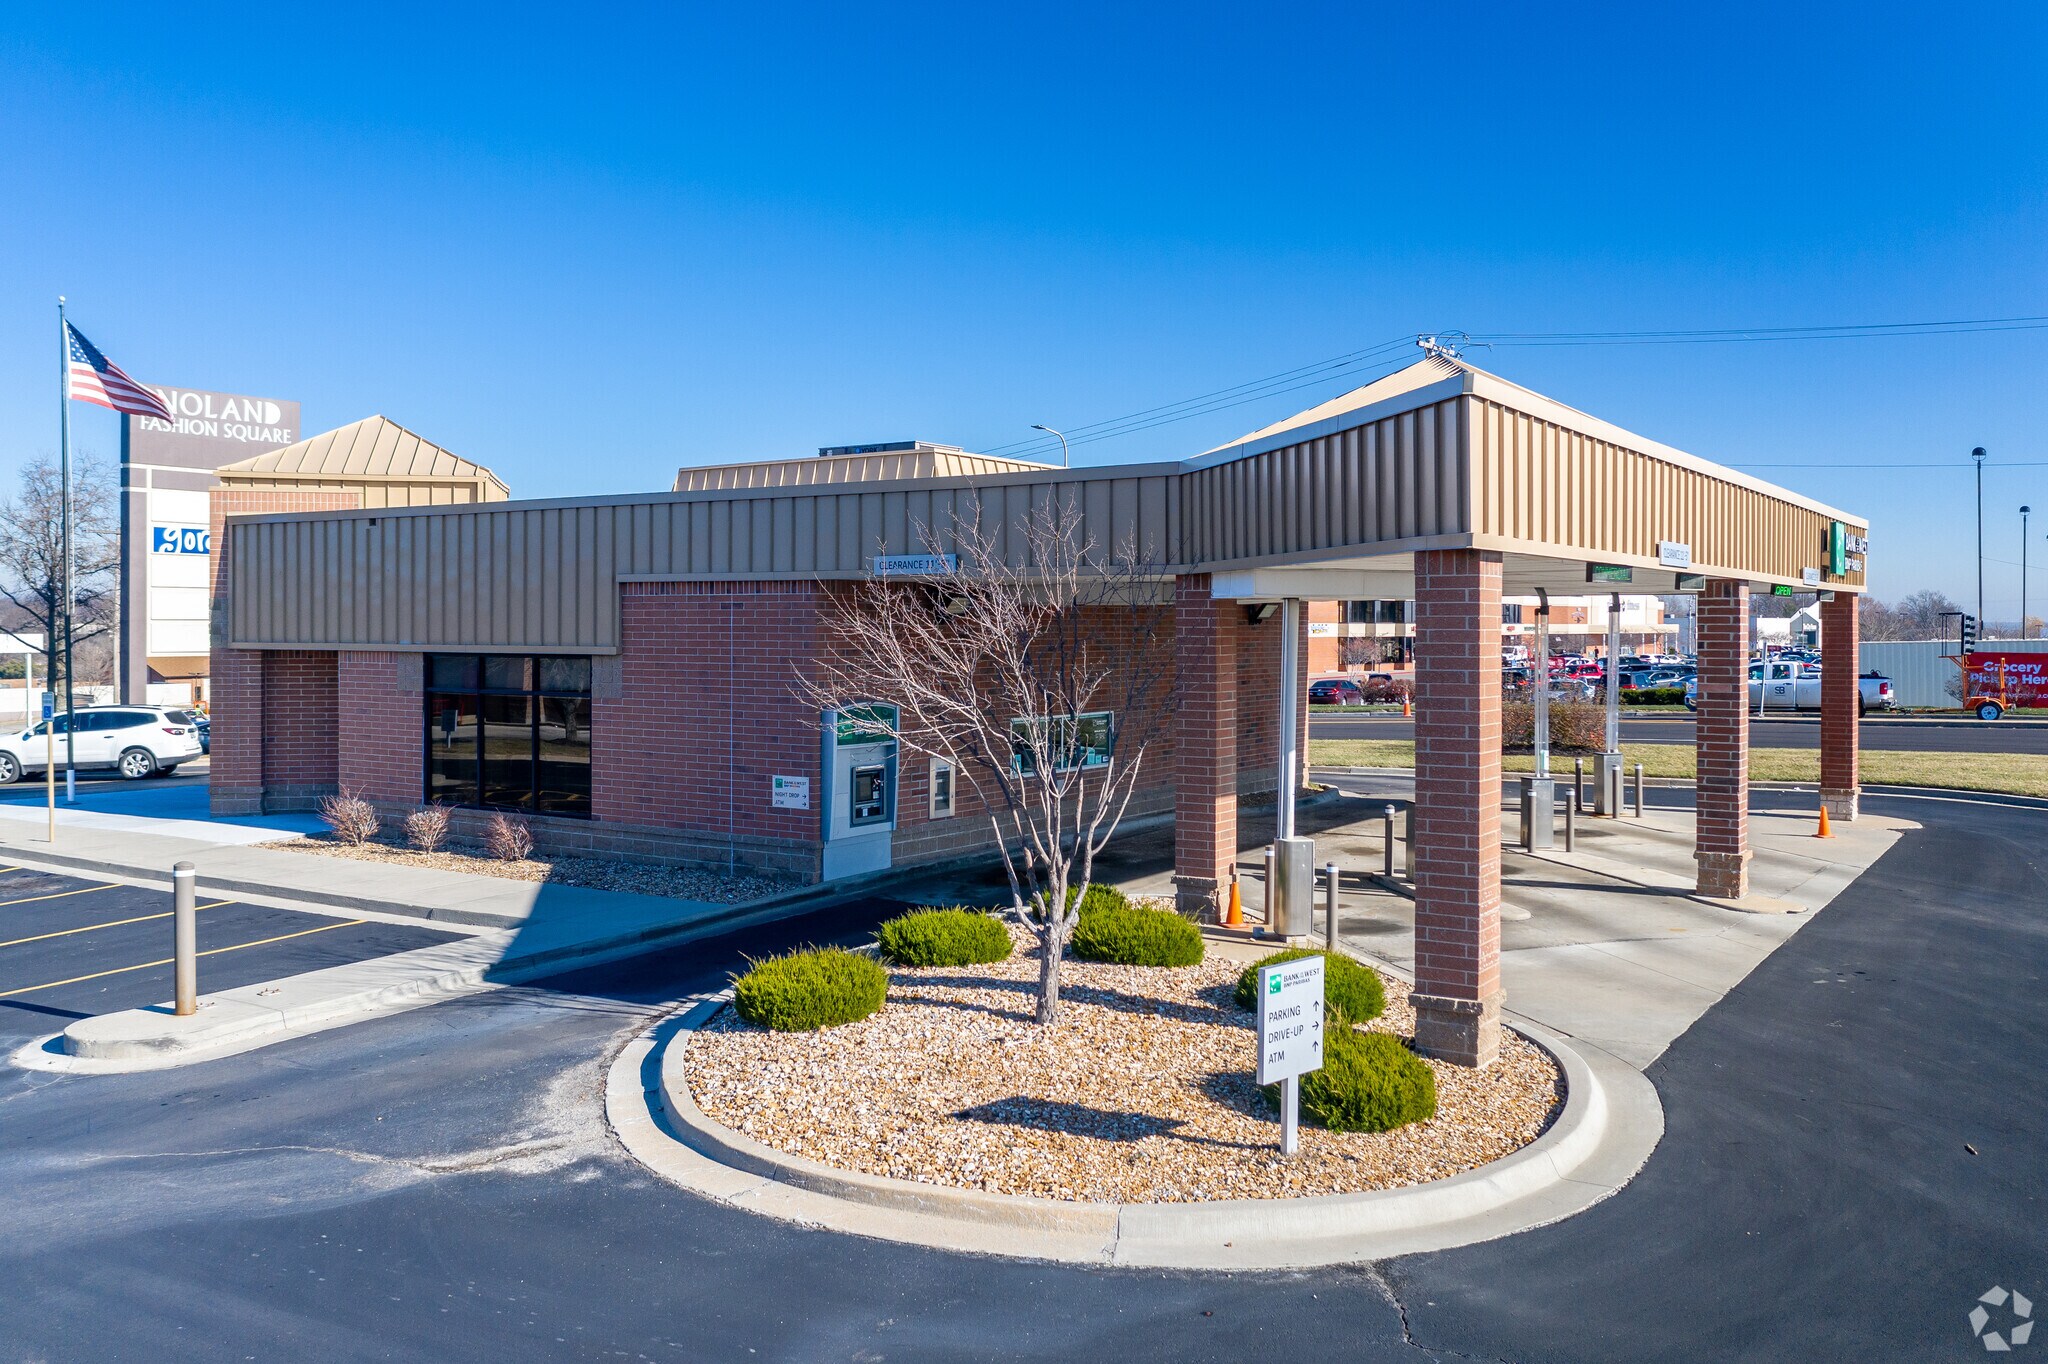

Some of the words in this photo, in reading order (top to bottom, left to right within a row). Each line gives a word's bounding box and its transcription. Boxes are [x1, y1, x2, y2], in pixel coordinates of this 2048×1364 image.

[157, 389, 281, 425] NOLAND
[140, 416, 218, 437] FASHION
[224, 422, 292, 444] SQUARE
[879, 560, 923, 570] CLEARANCE
[1775, 585, 1792, 596] OPEN
[1983, 661, 2042, 674] Grocery
[1283, 973, 1300, 983] BANK
[1304, 967, 1320, 977] WEST
[1283, 981, 1293, 989] BNP
[1268, 1004, 1301, 1023] PARKING
[1268, 1024, 1304, 1044] DRIVE-UP
[1268, 1050, 1285, 1064] ATM
